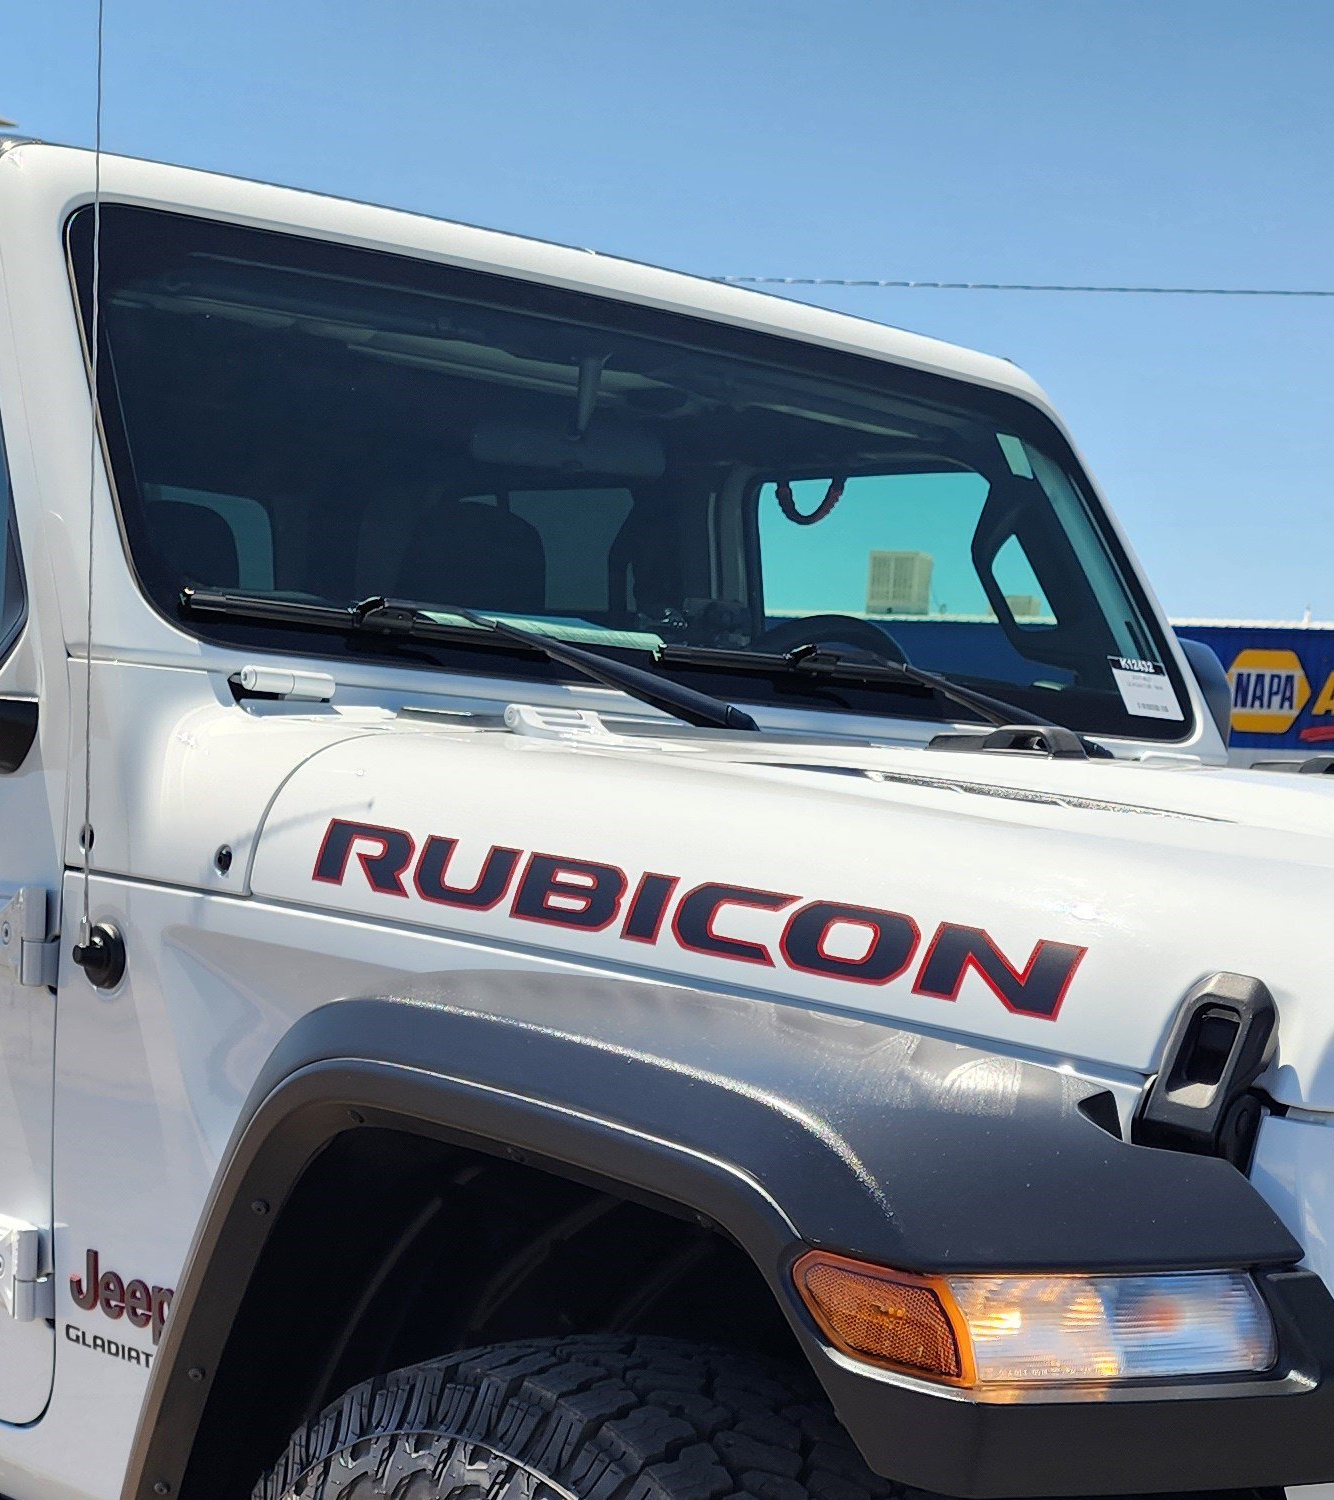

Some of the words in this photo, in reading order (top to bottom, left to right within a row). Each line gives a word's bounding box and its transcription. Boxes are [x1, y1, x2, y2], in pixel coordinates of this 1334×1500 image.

[1232, 671, 1296, 712] NAPA
[312, 818, 1088, 1022] RUBICON
[69, 1248, 174, 1346] Jeep
[65, 1324, 154, 1369] GLADIAT
